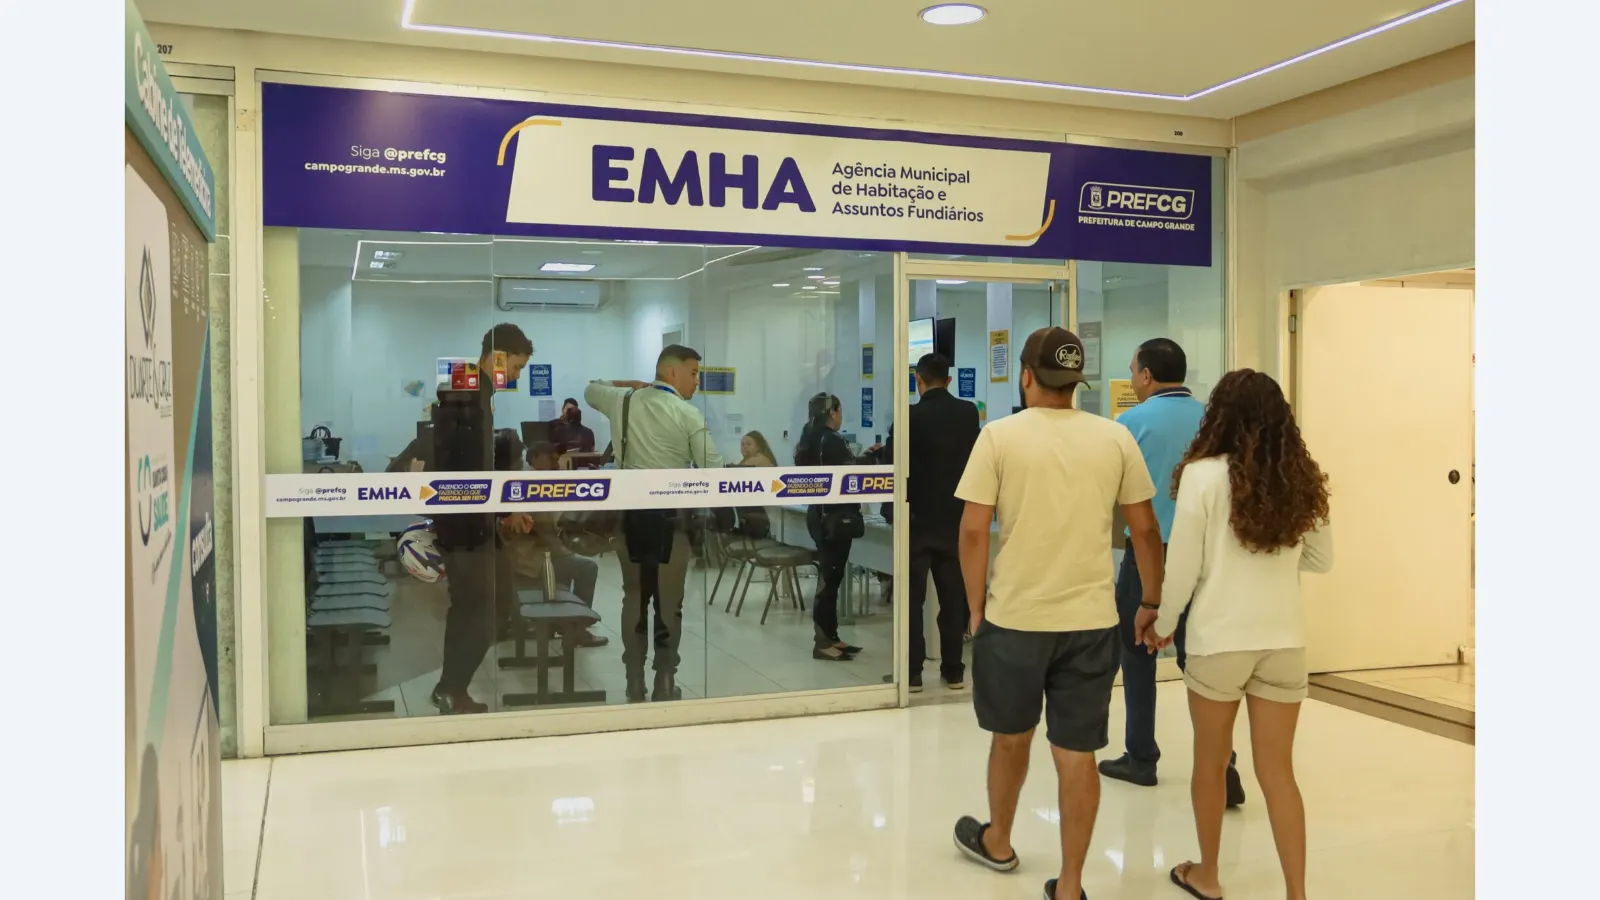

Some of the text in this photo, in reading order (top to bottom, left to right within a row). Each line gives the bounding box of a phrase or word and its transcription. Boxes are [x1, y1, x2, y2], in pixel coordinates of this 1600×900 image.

[157, 44, 172, 54] 207
[351, 145, 446, 164] Siga @prefcg
[304, 162, 446, 177] campogrande.ms.gov.br
[592, 144, 816, 212] EMHA
[832, 162, 970, 185] Agência Municipal
[832, 181, 947, 203] de Habitação e
[1106, 190, 1186, 213] PREFCG
[832, 202, 984, 222] Assuntos Fundiários
[1078, 216, 1195, 231] PREFEITURA DE CAMPO GRANDE
[358, 486, 412, 500] EMHA
[526, 483, 604, 498] PREFCG
[718, 481, 764, 493] EMHA
